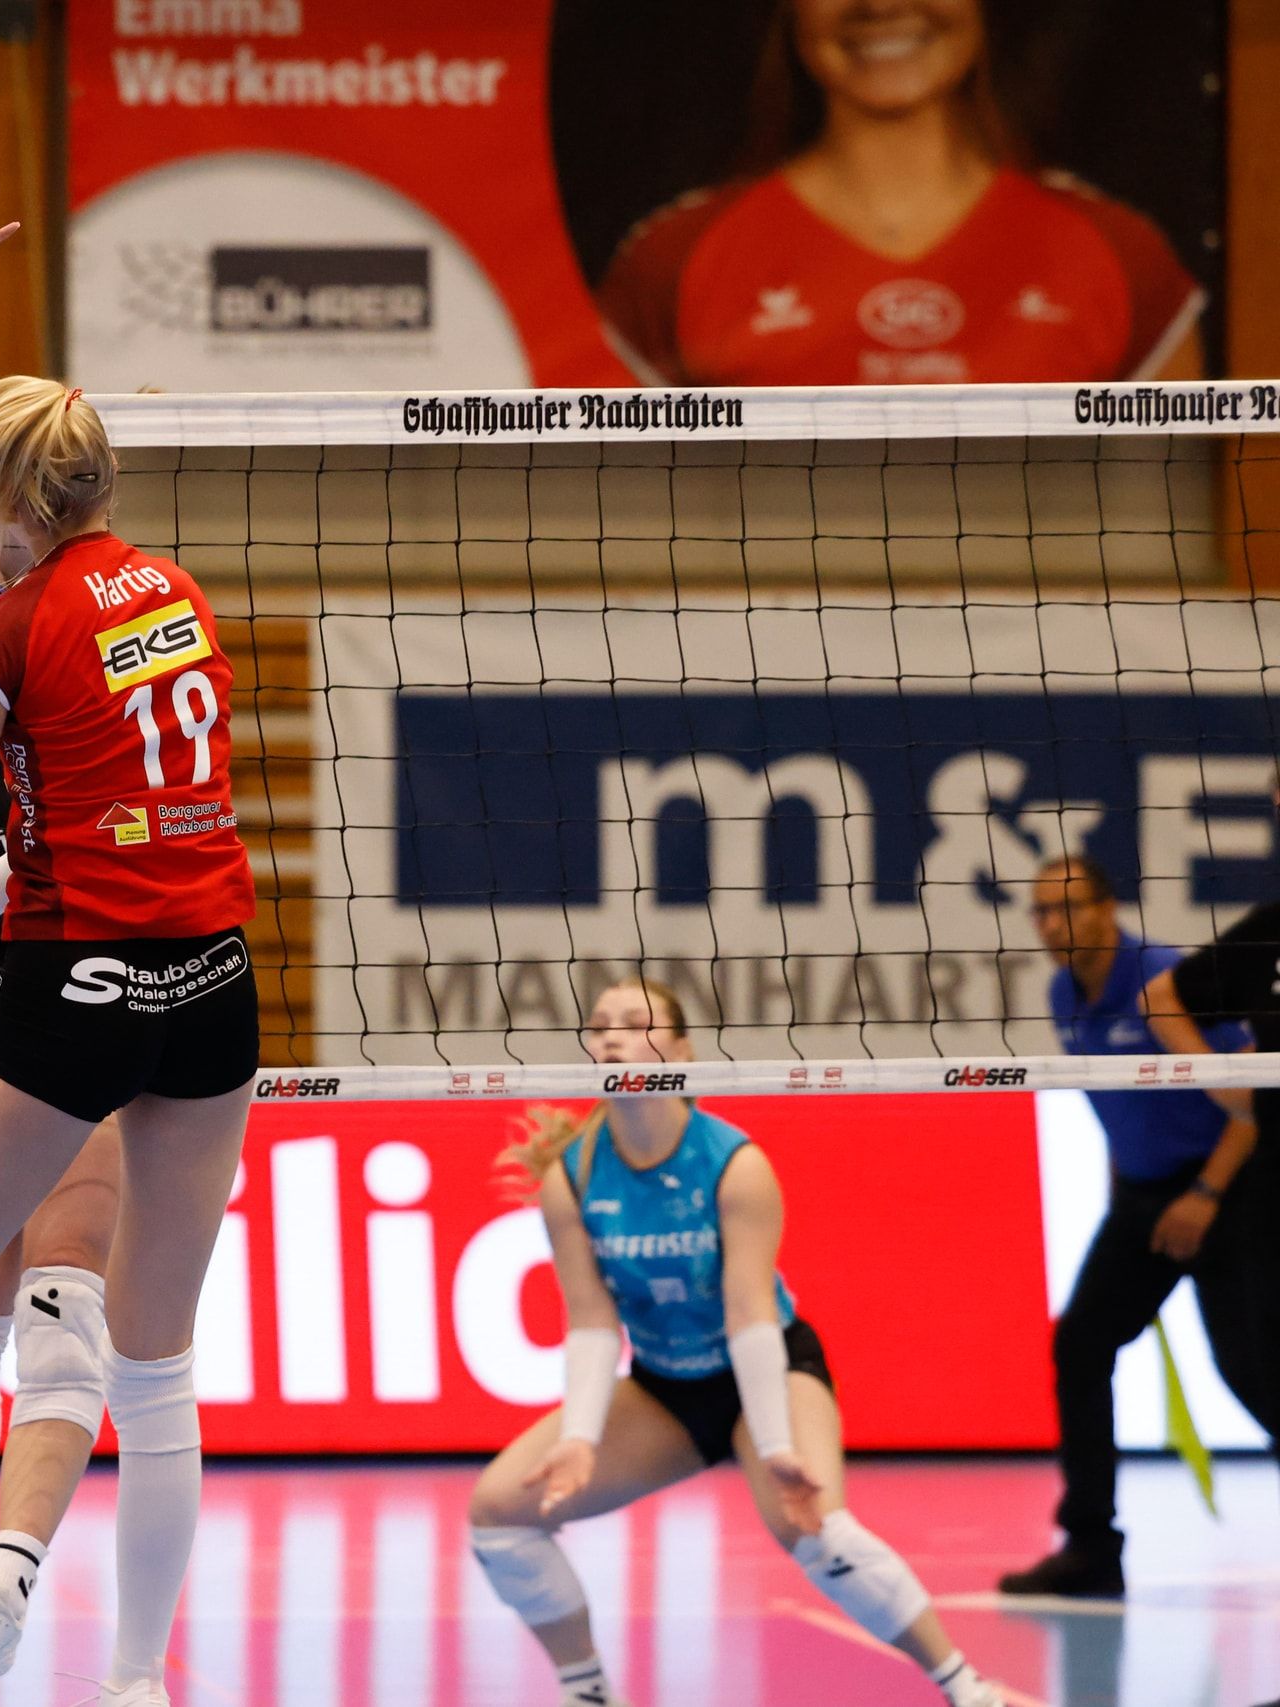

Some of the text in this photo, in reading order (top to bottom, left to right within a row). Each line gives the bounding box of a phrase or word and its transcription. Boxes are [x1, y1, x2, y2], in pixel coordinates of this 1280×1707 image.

[114, 0, 303, 38] Emma
[111, 44, 507, 108] Werkmeister
[403, 393, 744, 436] Schaffhauser Nachrichten
[1075, 387, 1243, 427] Schaffhauser
[84, 564, 171, 610] Hartig
[105, 615, 198, 674] EKS
[124, 671, 218, 790] 19
[158, 801, 222, 819] Bergauer
[160, 820, 214, 837] Holzbau
[61, 948, 220, 1004] Stauber
[126, 954, 242, 1001] Malergeschäft
[256, 1075, 341, 1098] GASSER
[603, 1070, 687, 1093] GASSER
[944, 1064, 1028, 1087] GASSER
